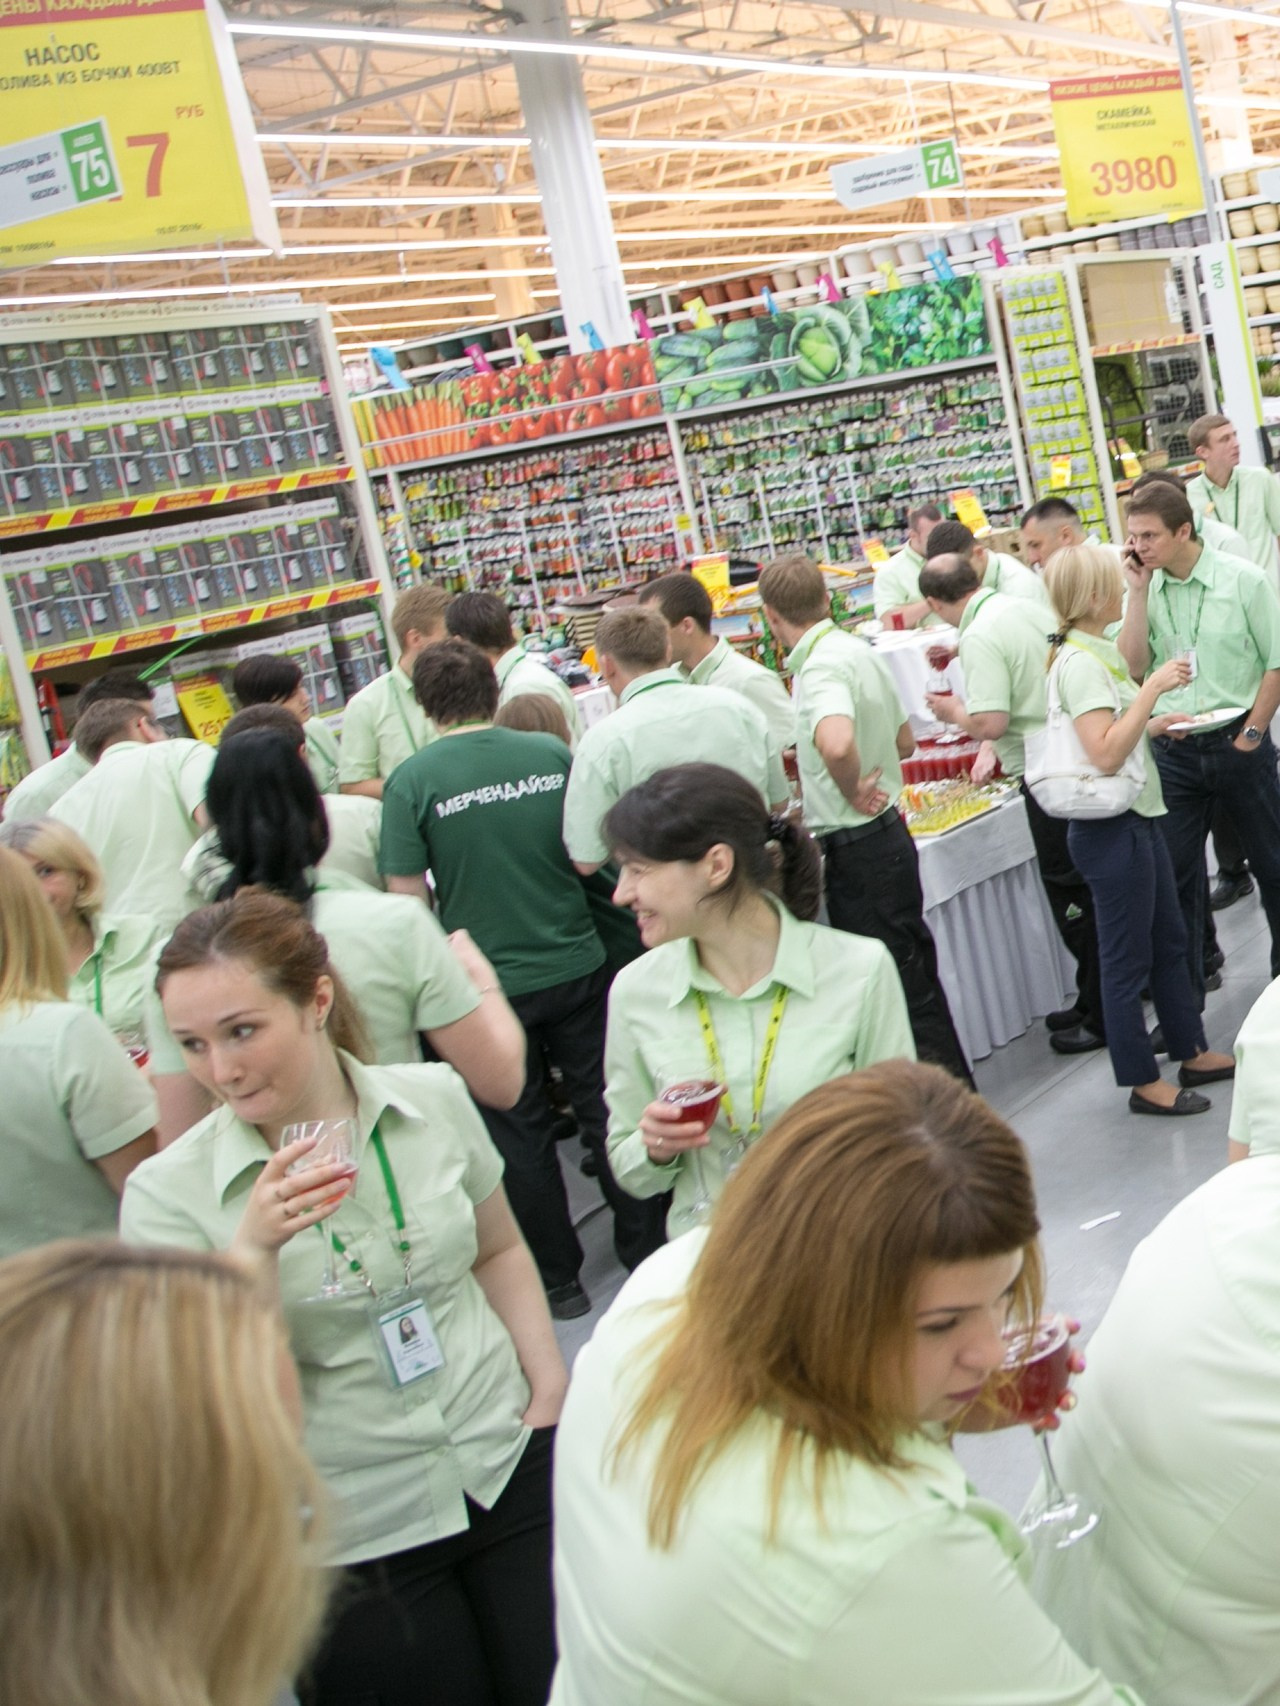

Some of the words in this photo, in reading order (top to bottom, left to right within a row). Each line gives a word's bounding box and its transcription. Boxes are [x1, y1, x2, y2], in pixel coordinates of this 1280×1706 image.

[0, 0, 41, 16] ЕНЫ
[25, 43, 100, 66] НАСОС
[56, 71, 78, 85] ИЗ
[81, 65, 132, 83] БОЧКИ
[175, 104, 205, 119] РУБ
[1096, 105, 1152, 120] СКАМЕЙКА
[71, 146, 111, 192] 75
[927, 154, 956, 184] 74
[1090, 154, 1177, 197] 3980
[1210, 260, 1225, 288] САД
[435, 773, 565, 818] МЕРЧЕНДАЙЗЕР
